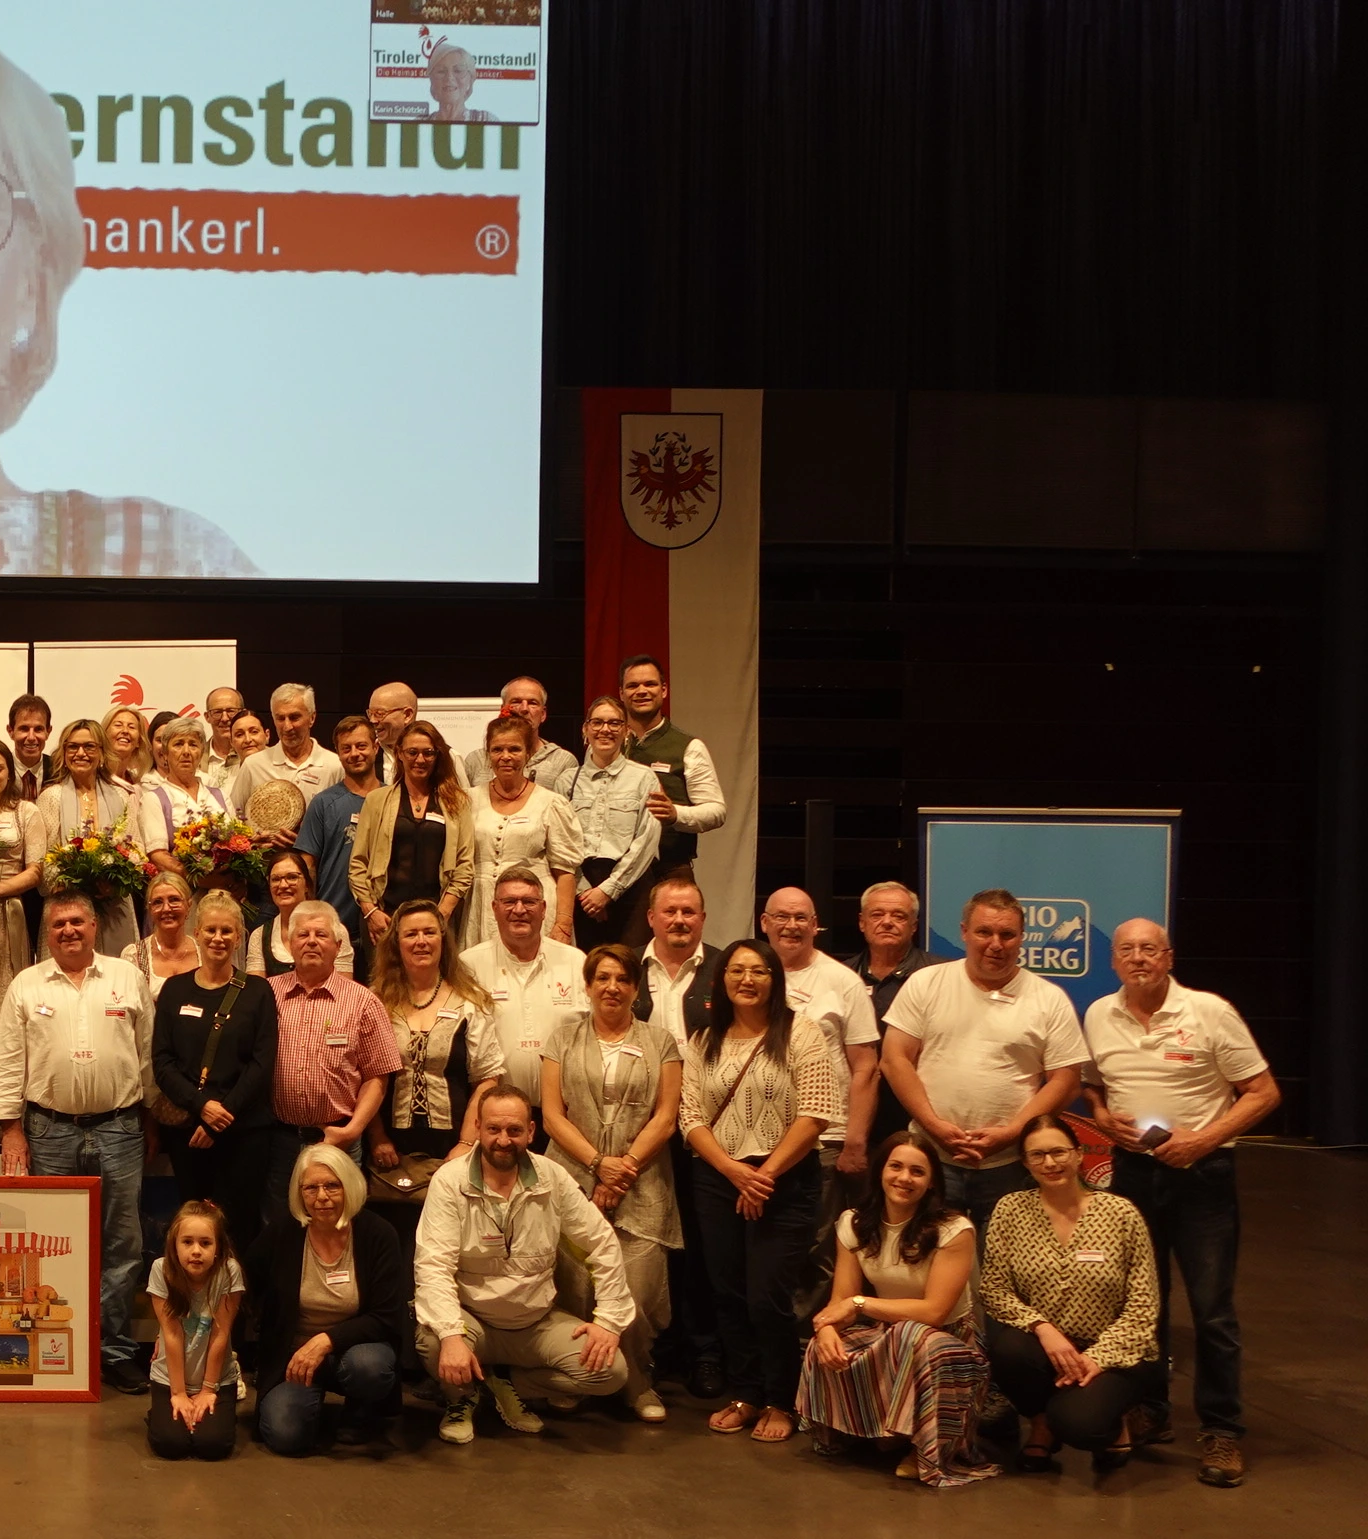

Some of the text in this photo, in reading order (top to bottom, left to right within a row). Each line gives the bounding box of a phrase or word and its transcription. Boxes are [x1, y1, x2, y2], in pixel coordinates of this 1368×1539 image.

[375, 10, 395, 18] Halle
[373, 50, 536, 66] Tiroler ernstandl
[374, 104, 393, 113] Karin
[83, 205, 281, 256] ankerl.
